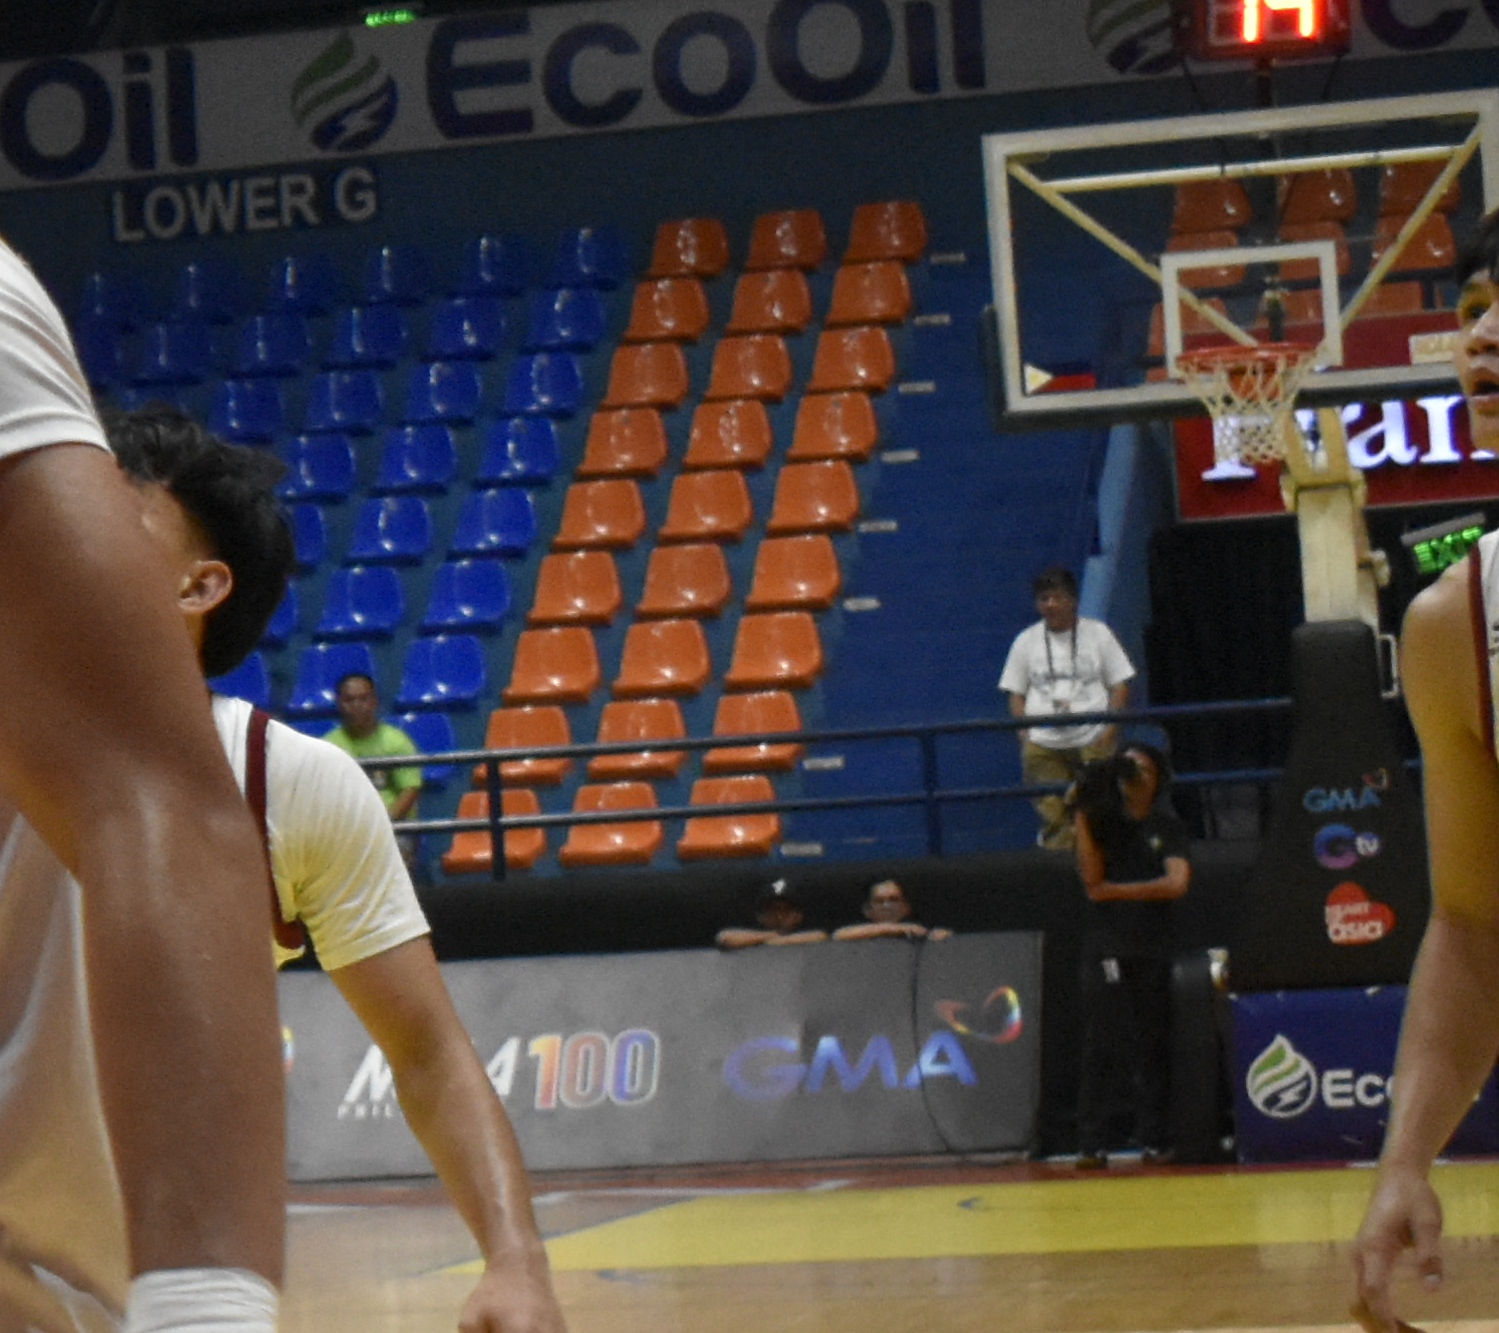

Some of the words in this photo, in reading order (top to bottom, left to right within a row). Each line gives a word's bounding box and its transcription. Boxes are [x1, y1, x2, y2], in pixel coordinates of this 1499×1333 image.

[113, 172, 320, 243] LOWER
[333, 165, 378, 221] G
[1302, 784, 1383, 814] GMA
[526, 1027, 661, 1110] 100
[721, 1029, 979, 1102] GMA
